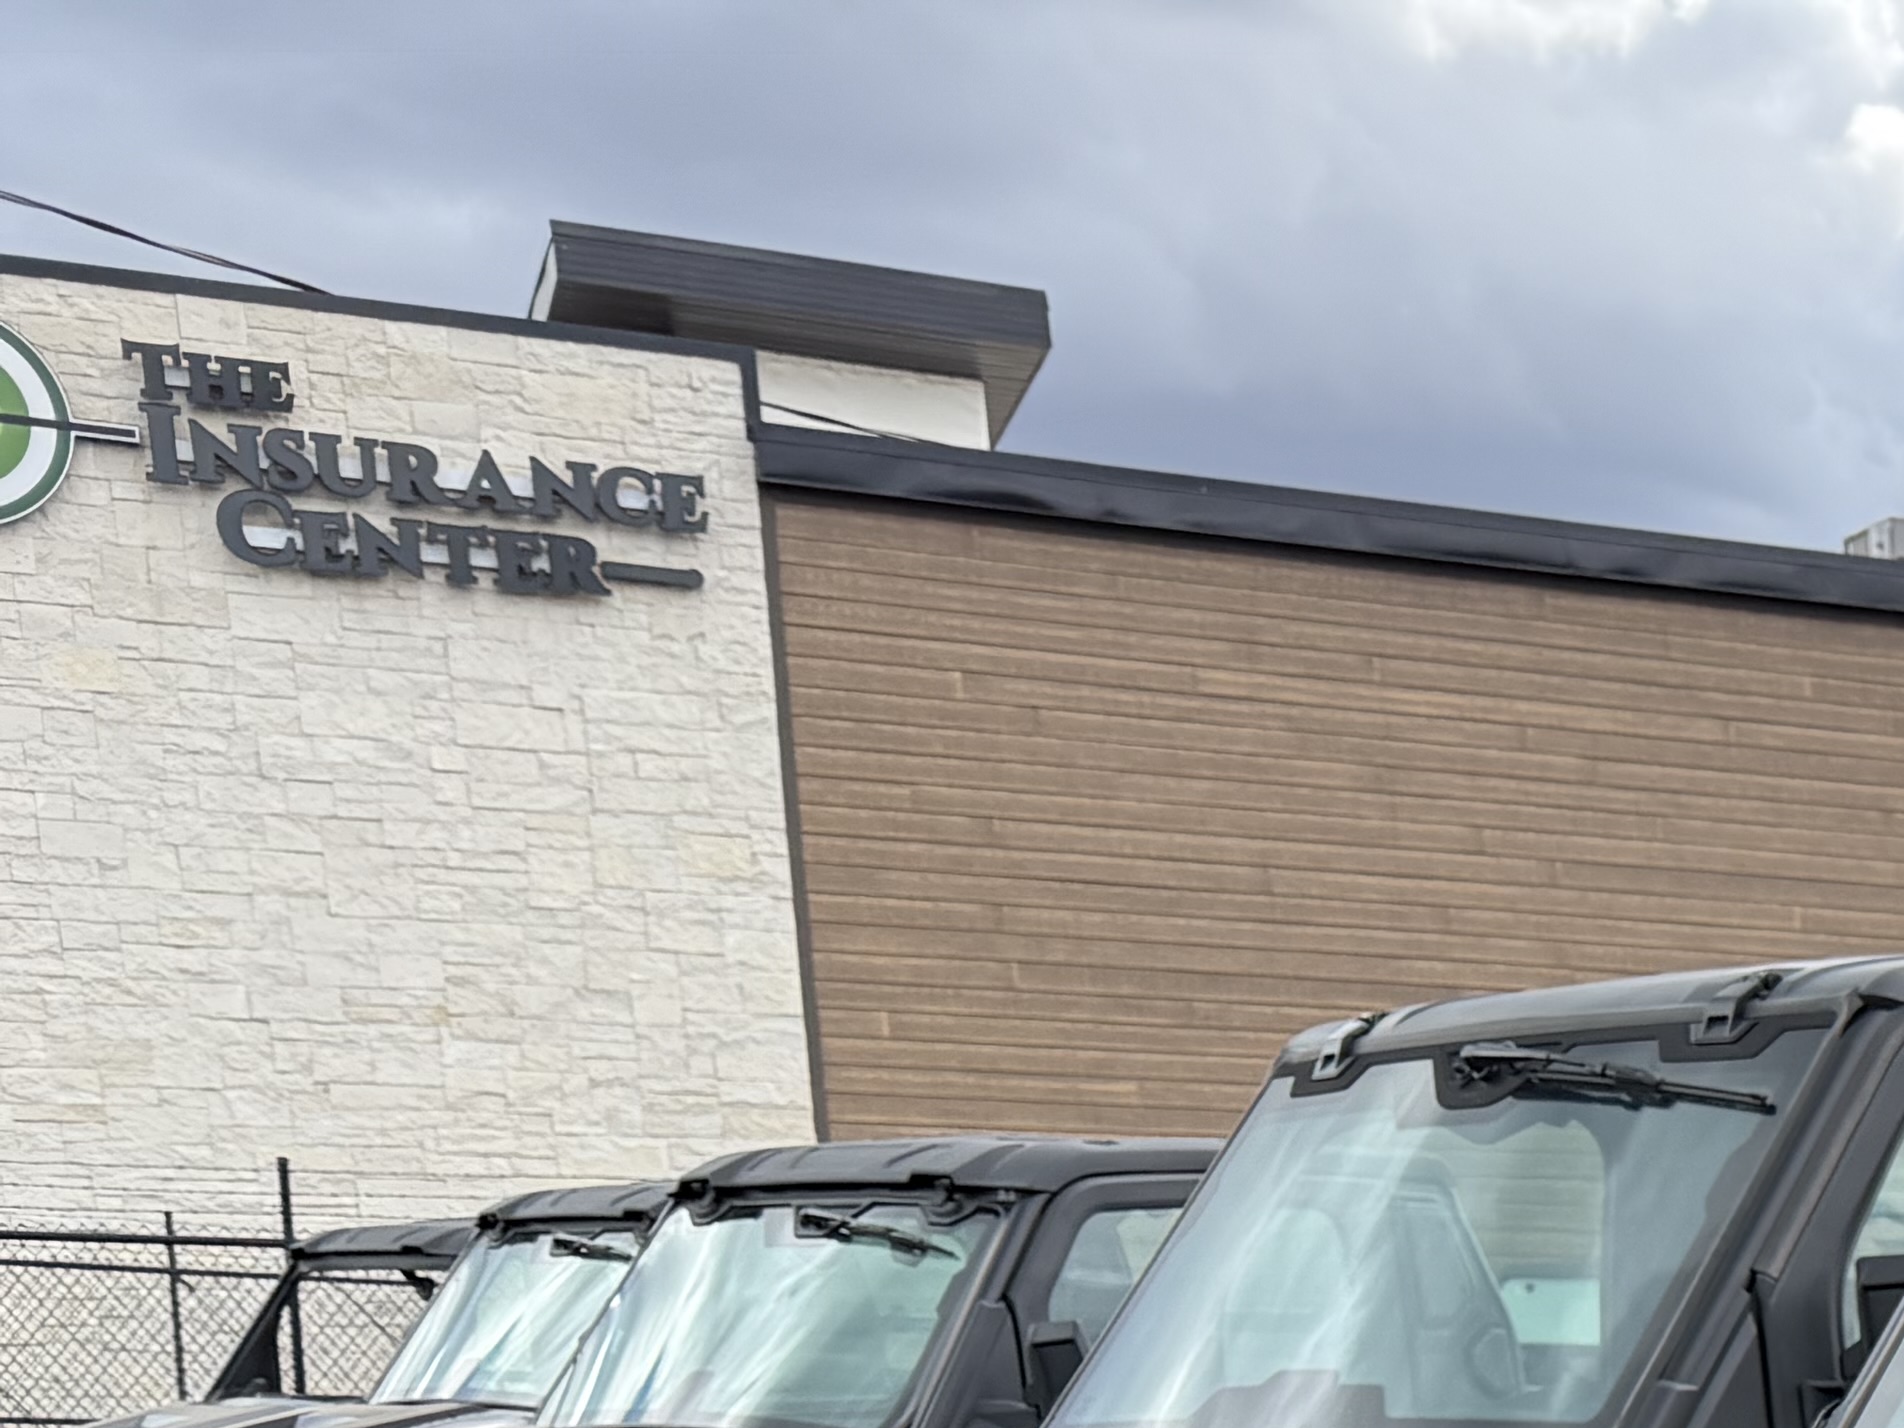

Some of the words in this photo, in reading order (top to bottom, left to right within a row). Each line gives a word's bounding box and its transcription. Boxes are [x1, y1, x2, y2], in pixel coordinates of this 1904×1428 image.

[121, 338, 295, 413] THE
[138, 402, 707, 534] INSURANCE
[216, 487, 609, 596] CENTER
